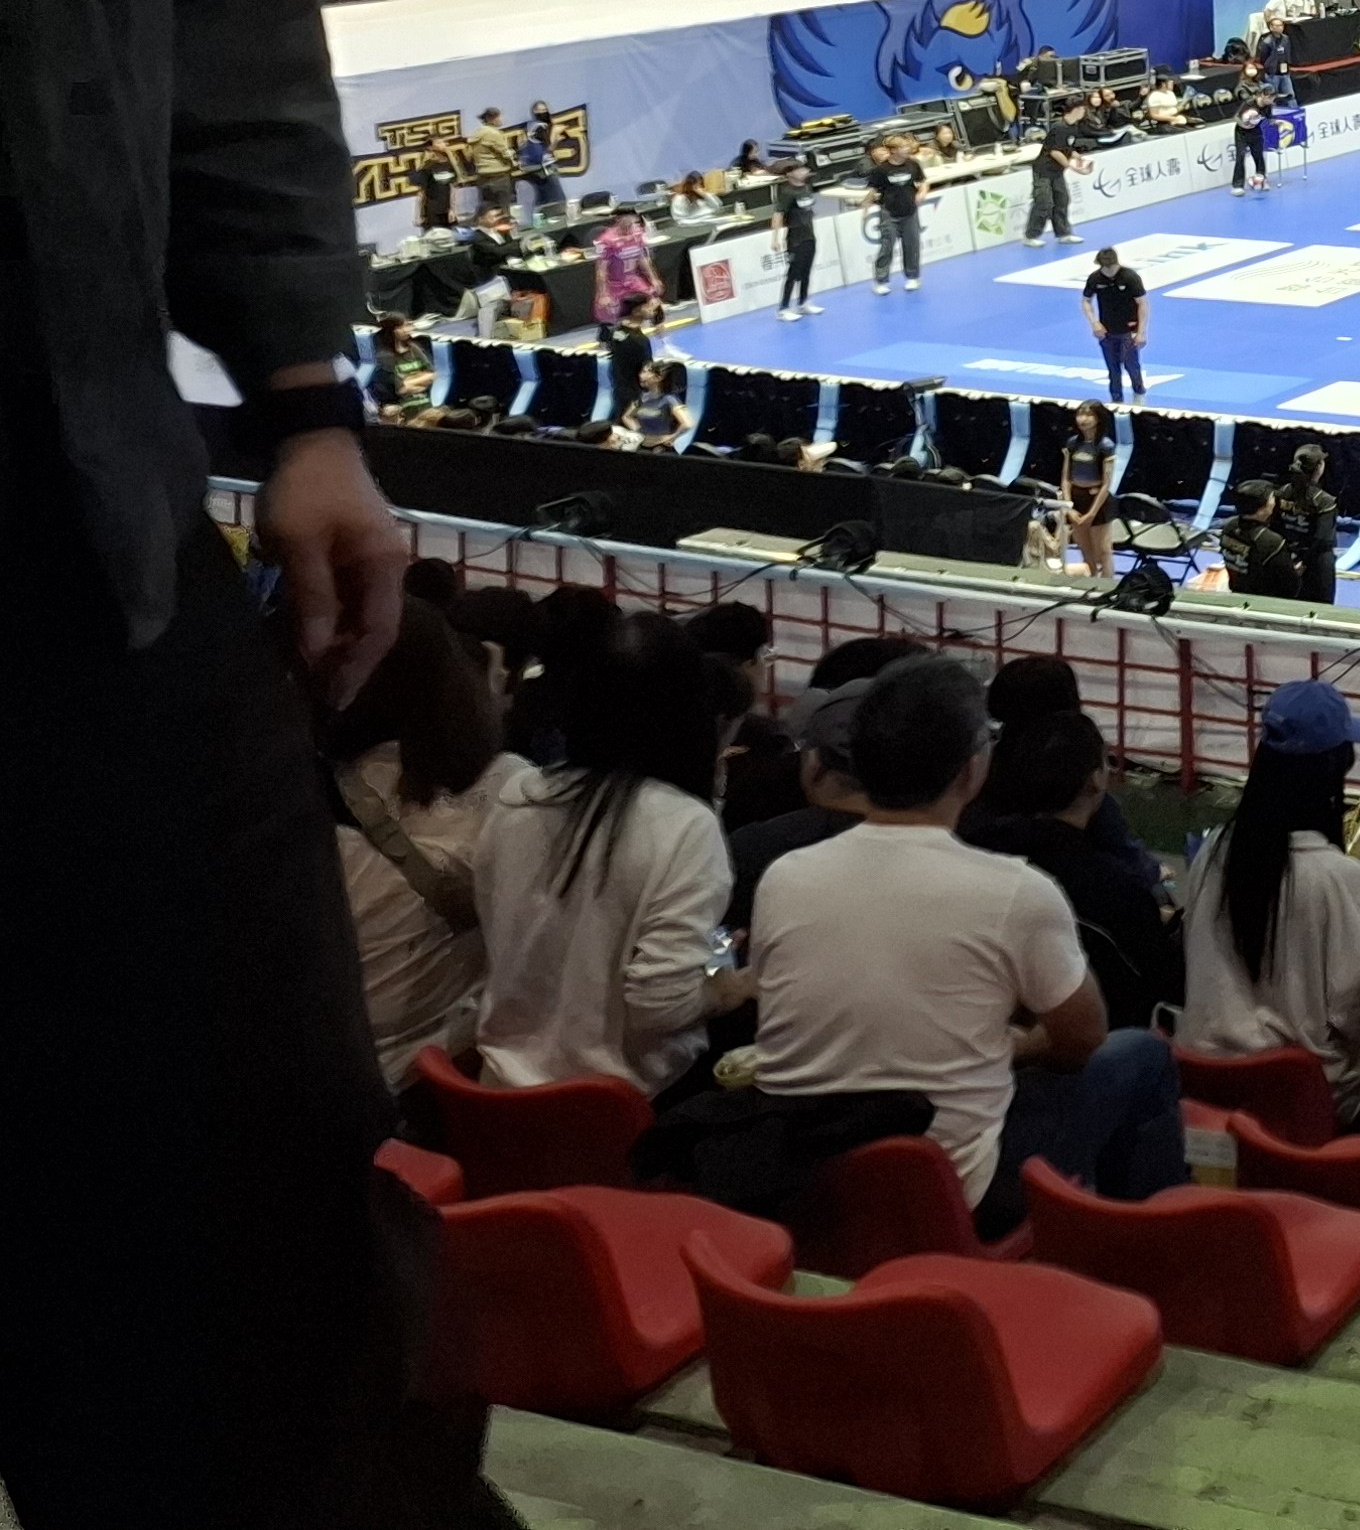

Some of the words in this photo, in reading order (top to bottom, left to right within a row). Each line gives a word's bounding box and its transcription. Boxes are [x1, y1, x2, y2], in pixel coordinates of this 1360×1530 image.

[379, 112, 460, 149] TSG
[1125, 157, 1181, 187] 全球人壽
